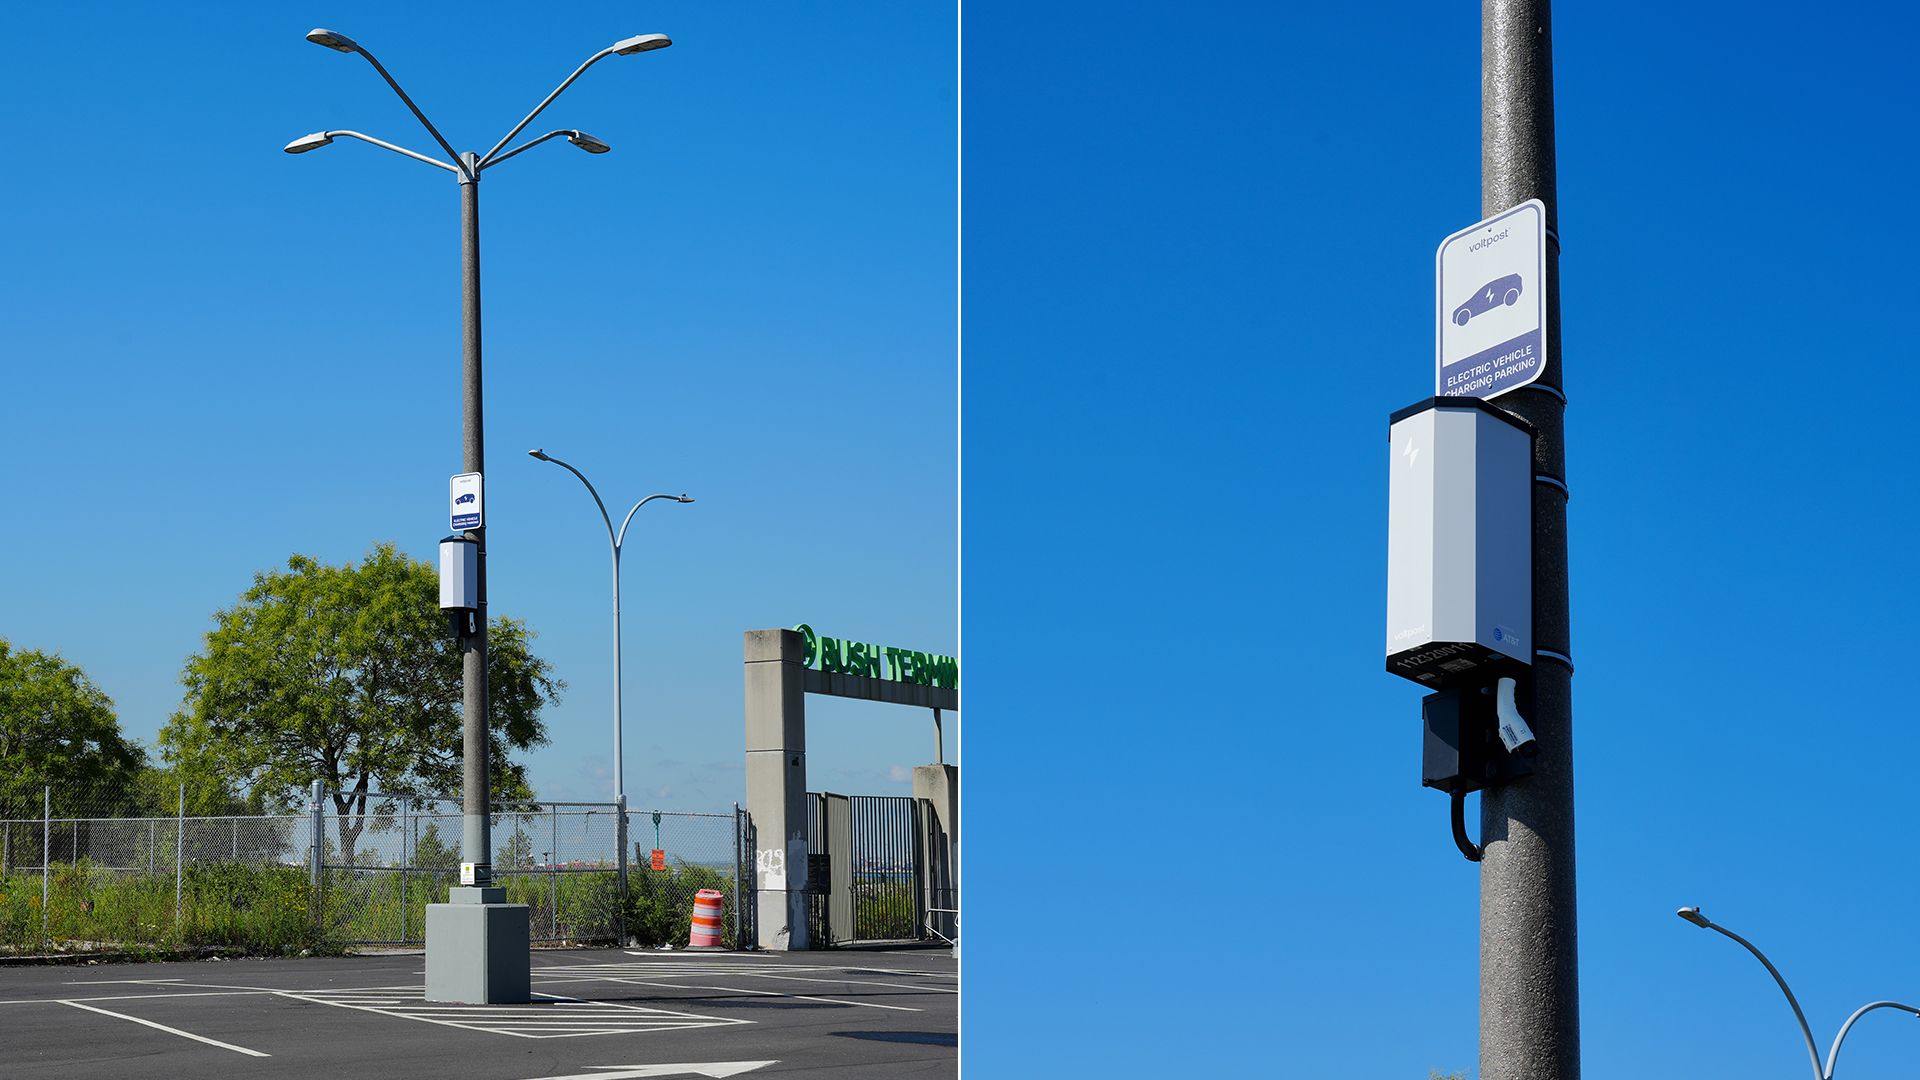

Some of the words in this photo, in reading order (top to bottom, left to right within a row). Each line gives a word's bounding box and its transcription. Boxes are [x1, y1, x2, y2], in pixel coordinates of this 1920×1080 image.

[1469, 229, 1509, 252] voltpost
[1447, 362, 1491, 387] ELECTRIC
[1493, 345, 1533, 368] VEHICLE
[1494, 357, 1536, 381] PARKING
[816, 635, 882, 680] BUSH
